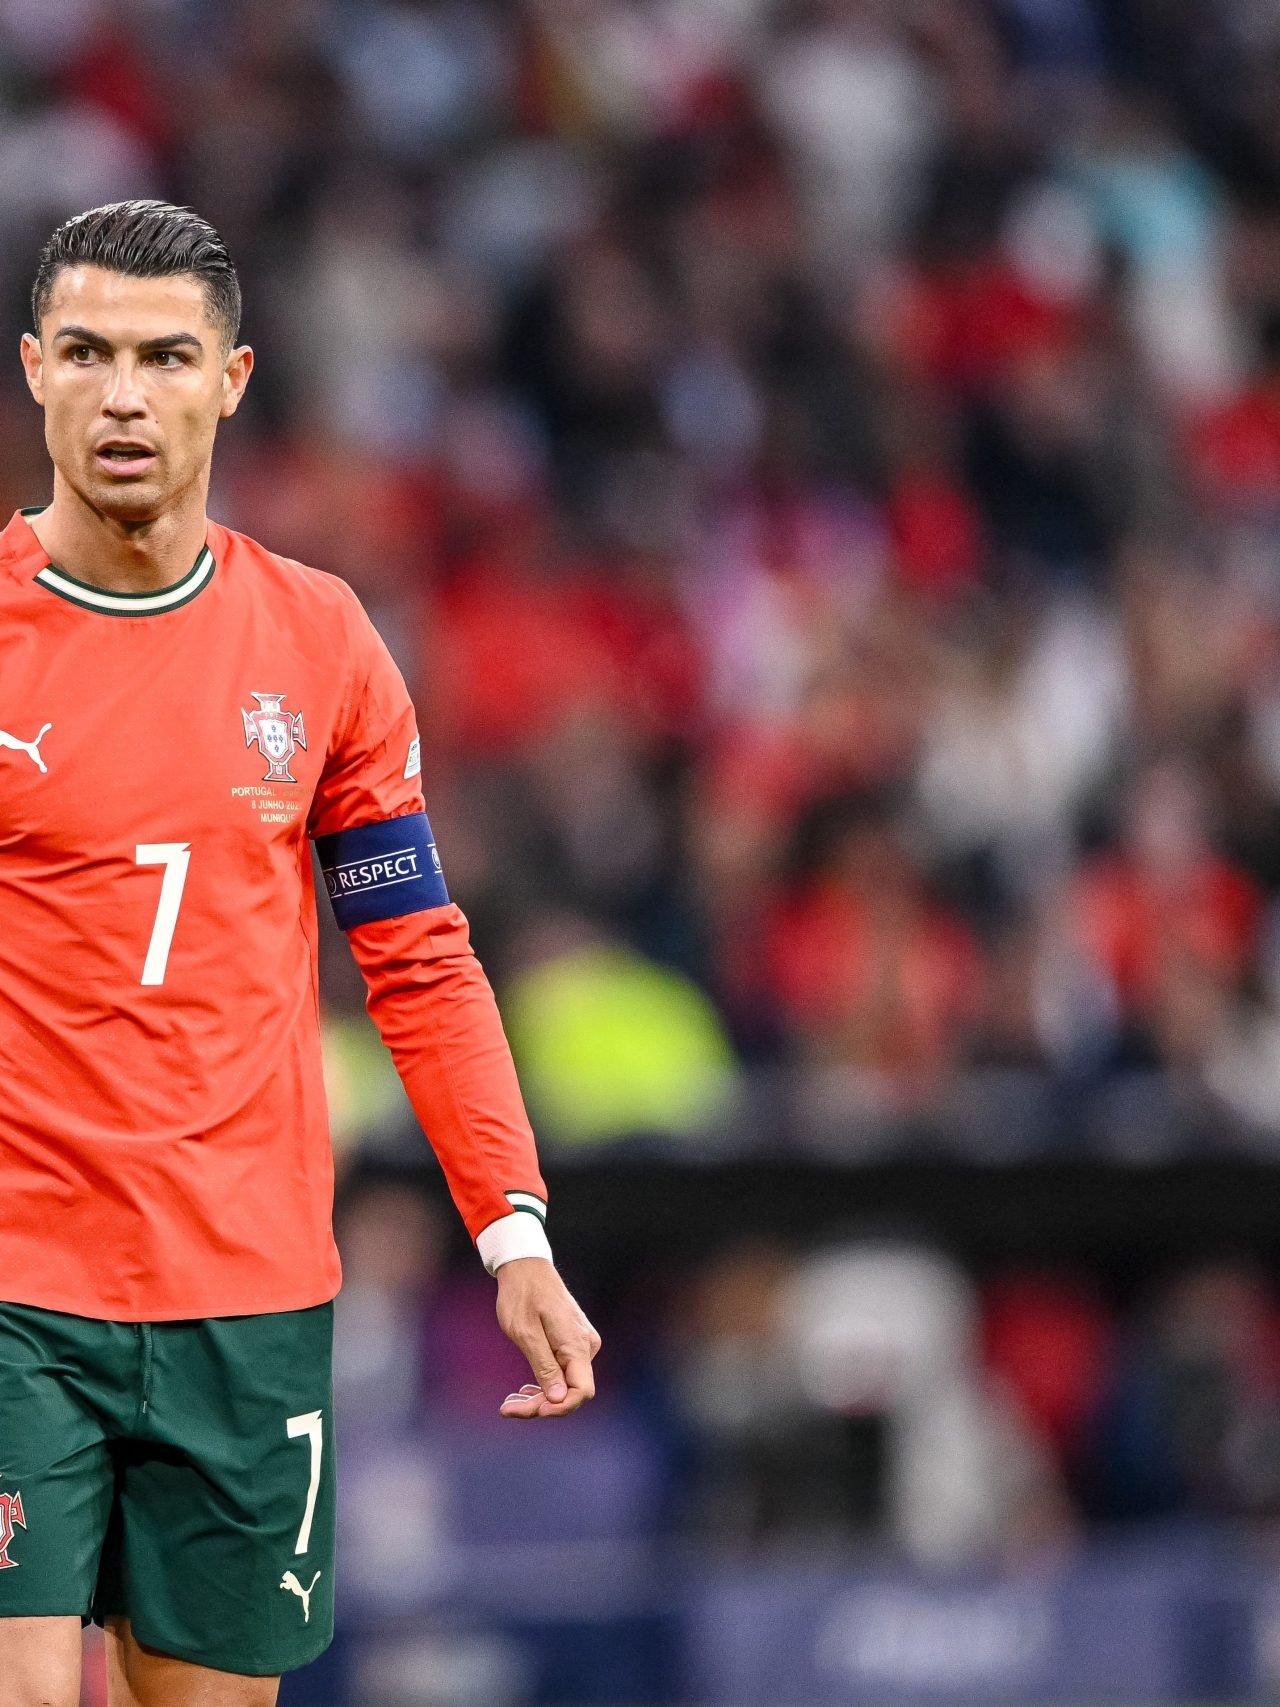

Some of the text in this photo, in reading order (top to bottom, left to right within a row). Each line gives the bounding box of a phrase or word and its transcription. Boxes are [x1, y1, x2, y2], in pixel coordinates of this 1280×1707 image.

[231, 786, 277, 797] PORTUGAL
[258, 800, 284, 810] JUNHO
[286, 801, 303, 810] 202
[338, 854, 417, 889] RESPECT
[135, 842, 192, 986] 7
[286, 1409, 323, 1555] 7
